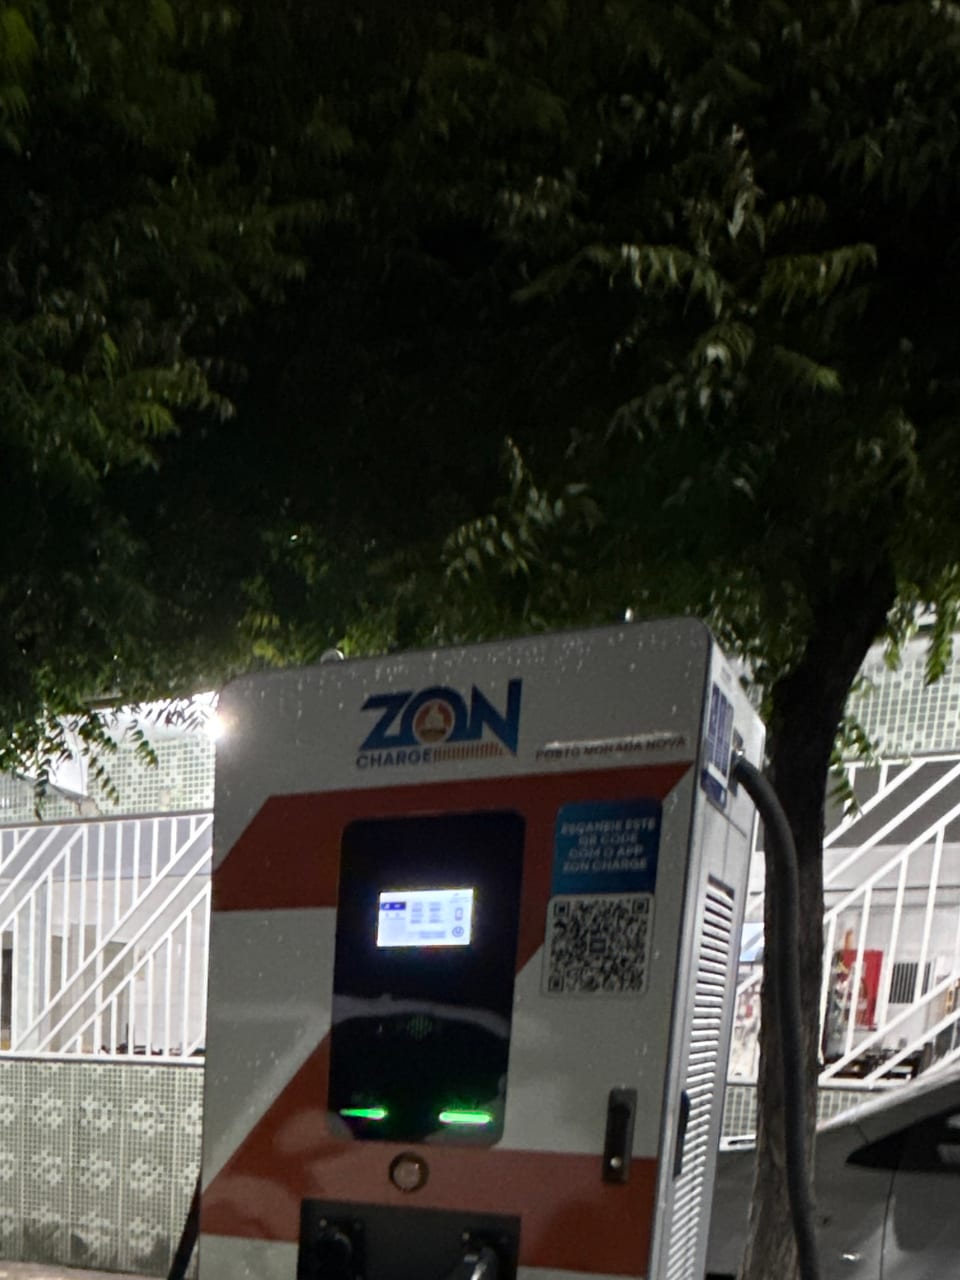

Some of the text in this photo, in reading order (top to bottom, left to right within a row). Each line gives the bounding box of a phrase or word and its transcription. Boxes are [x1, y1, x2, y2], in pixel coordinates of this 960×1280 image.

[359, 678, 523, 758] ZON
[356, 748, 432, 768] CHARGE
[561, 817, 656, 835] ESCANEIE ESTE
[579, 831, 639, 848] QR CODE
[617, 843, 645, 857] APP
[562, 857, 648, 872] ZON CHARGE
